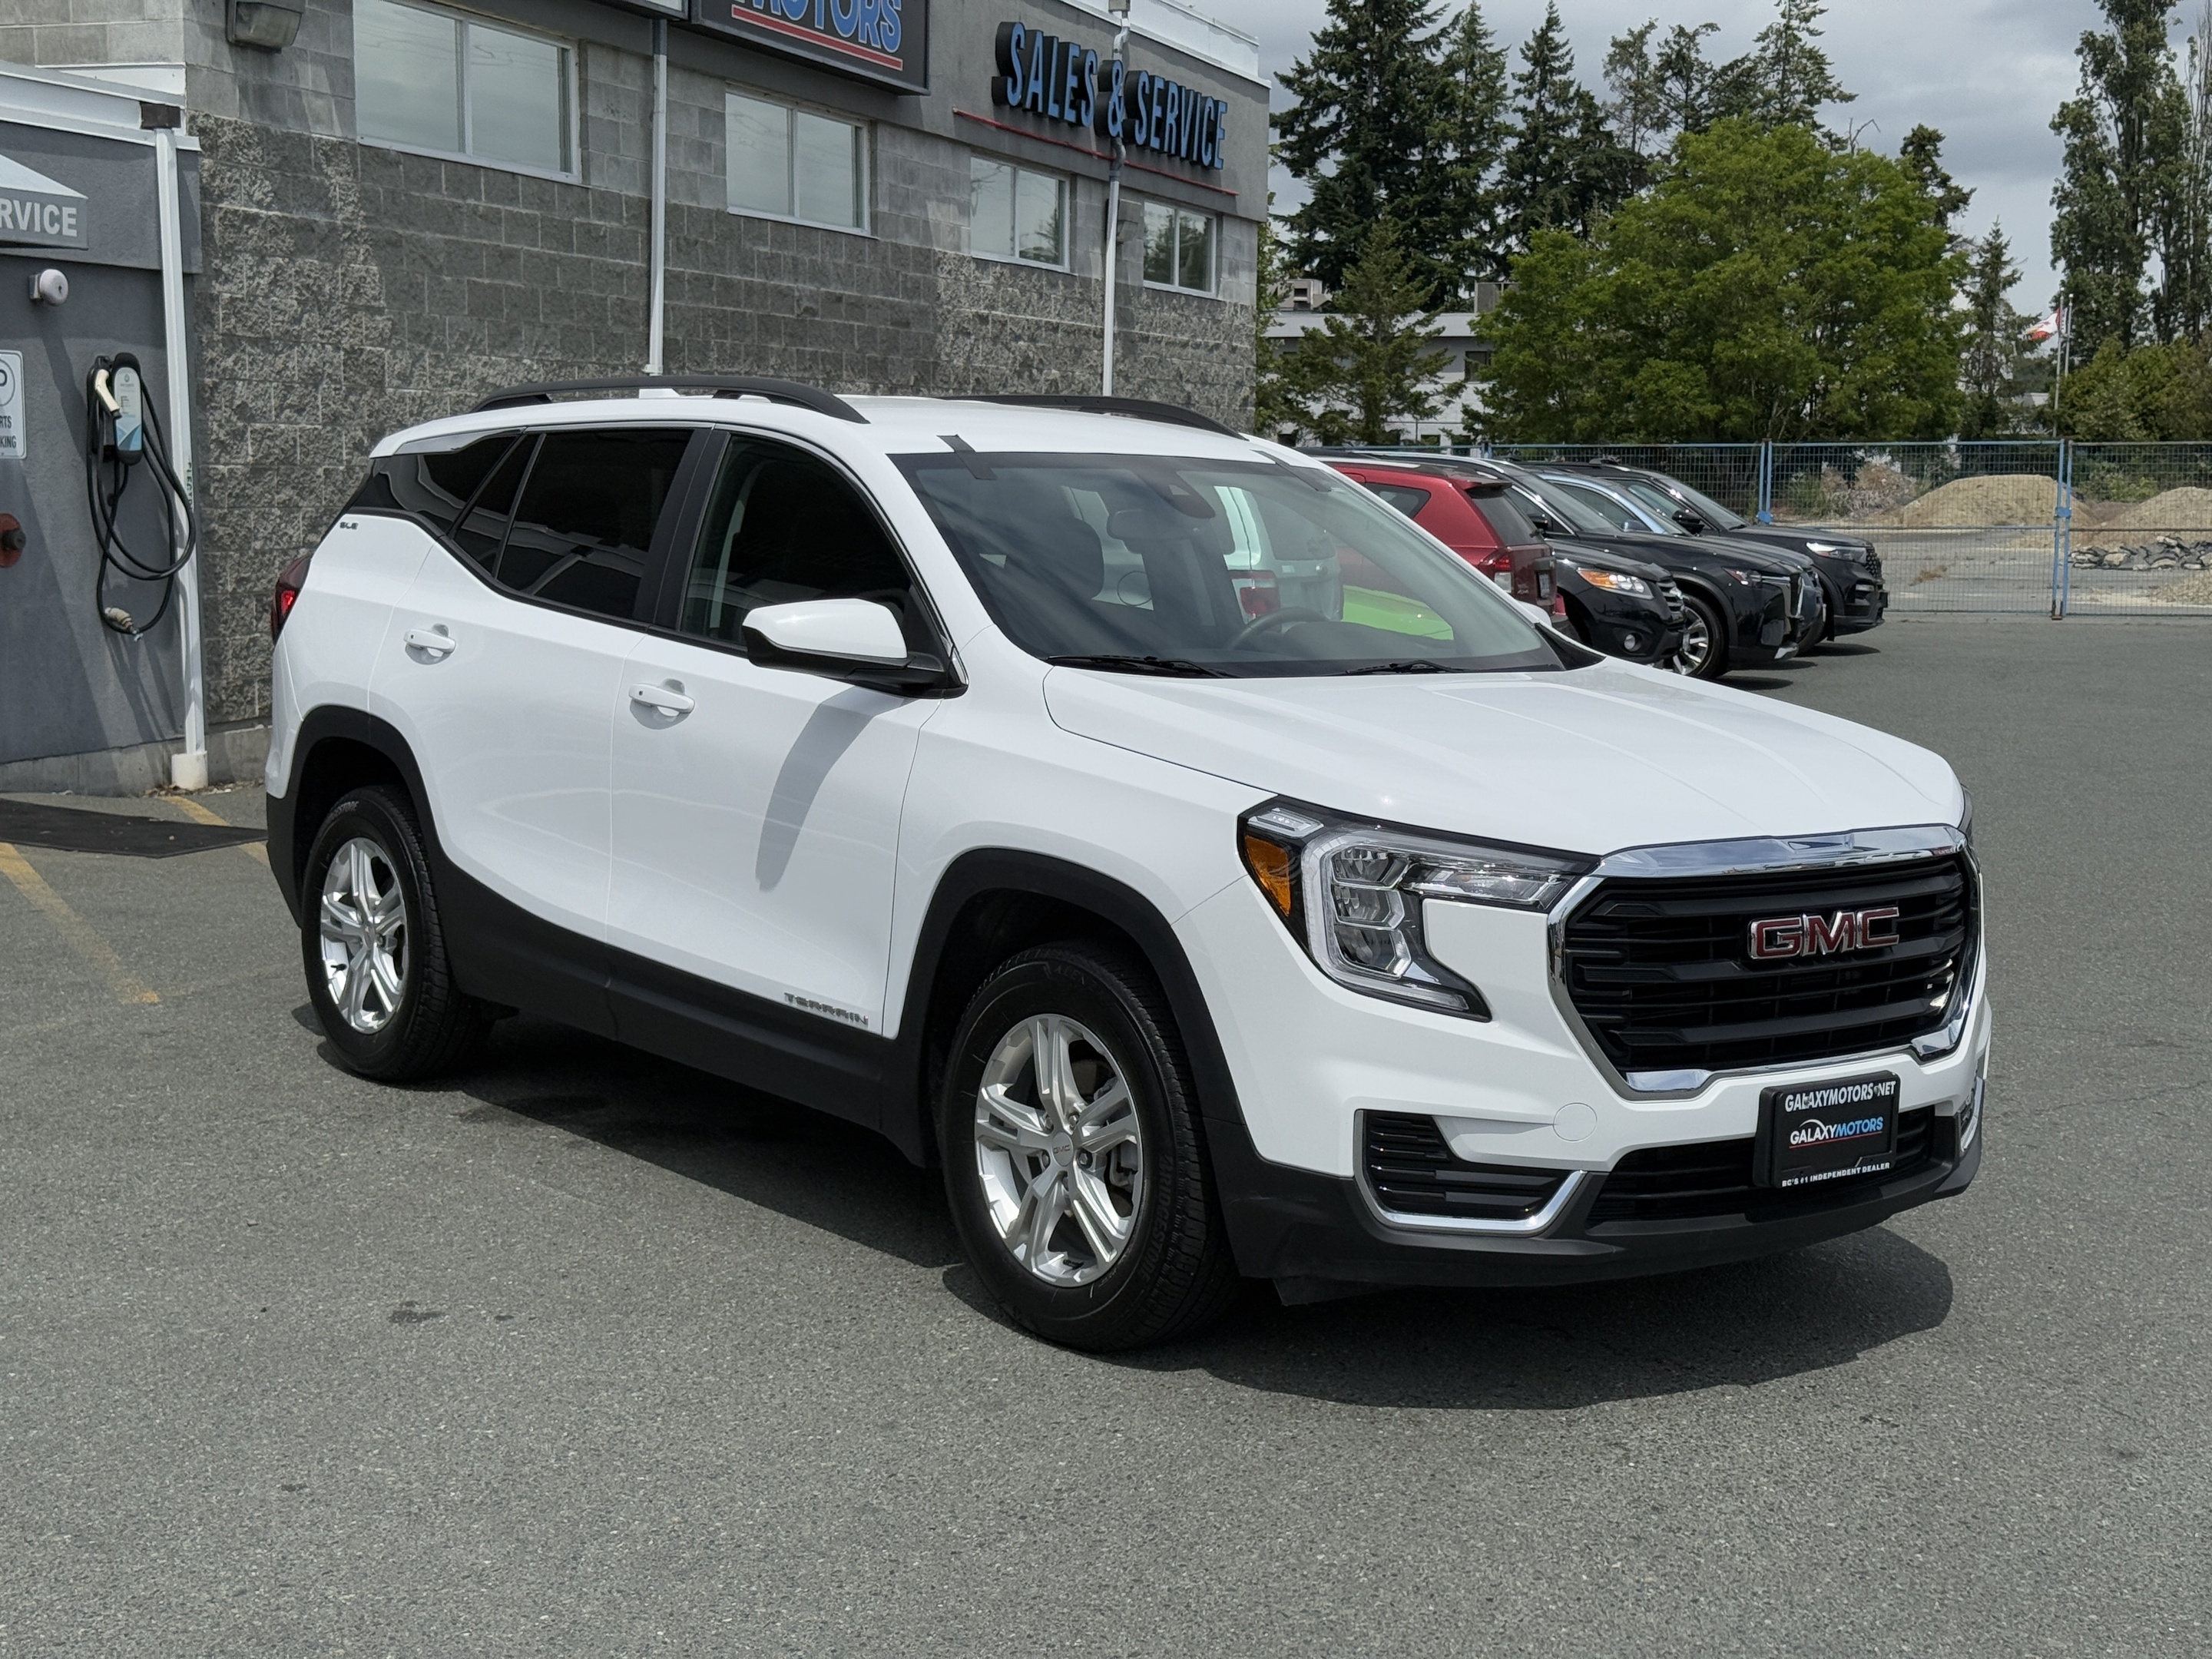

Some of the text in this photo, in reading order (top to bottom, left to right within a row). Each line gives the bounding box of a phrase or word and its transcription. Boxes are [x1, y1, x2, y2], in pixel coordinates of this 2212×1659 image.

[1001, 22, 1227, 170] SALES & SERVICE
[0, 198, 78, 237] RVICE
[1749, 906, 1900, 959] GMC
[784, 992, 869, 1027] TERRAIN
[1785, 1081, 1896, 1113] GALAXYMOTORSNET
[1790, 1116, 1884, 1145] GALAXYMOTORS
[1053, 1144, 1071, 1154] GMC
[1782, 1177, 1800, 1187] BC'S
[1810, 1167, 1861, 1182] INDEPENDENT
[1862, 1162, 1890, 1173] DEALER
